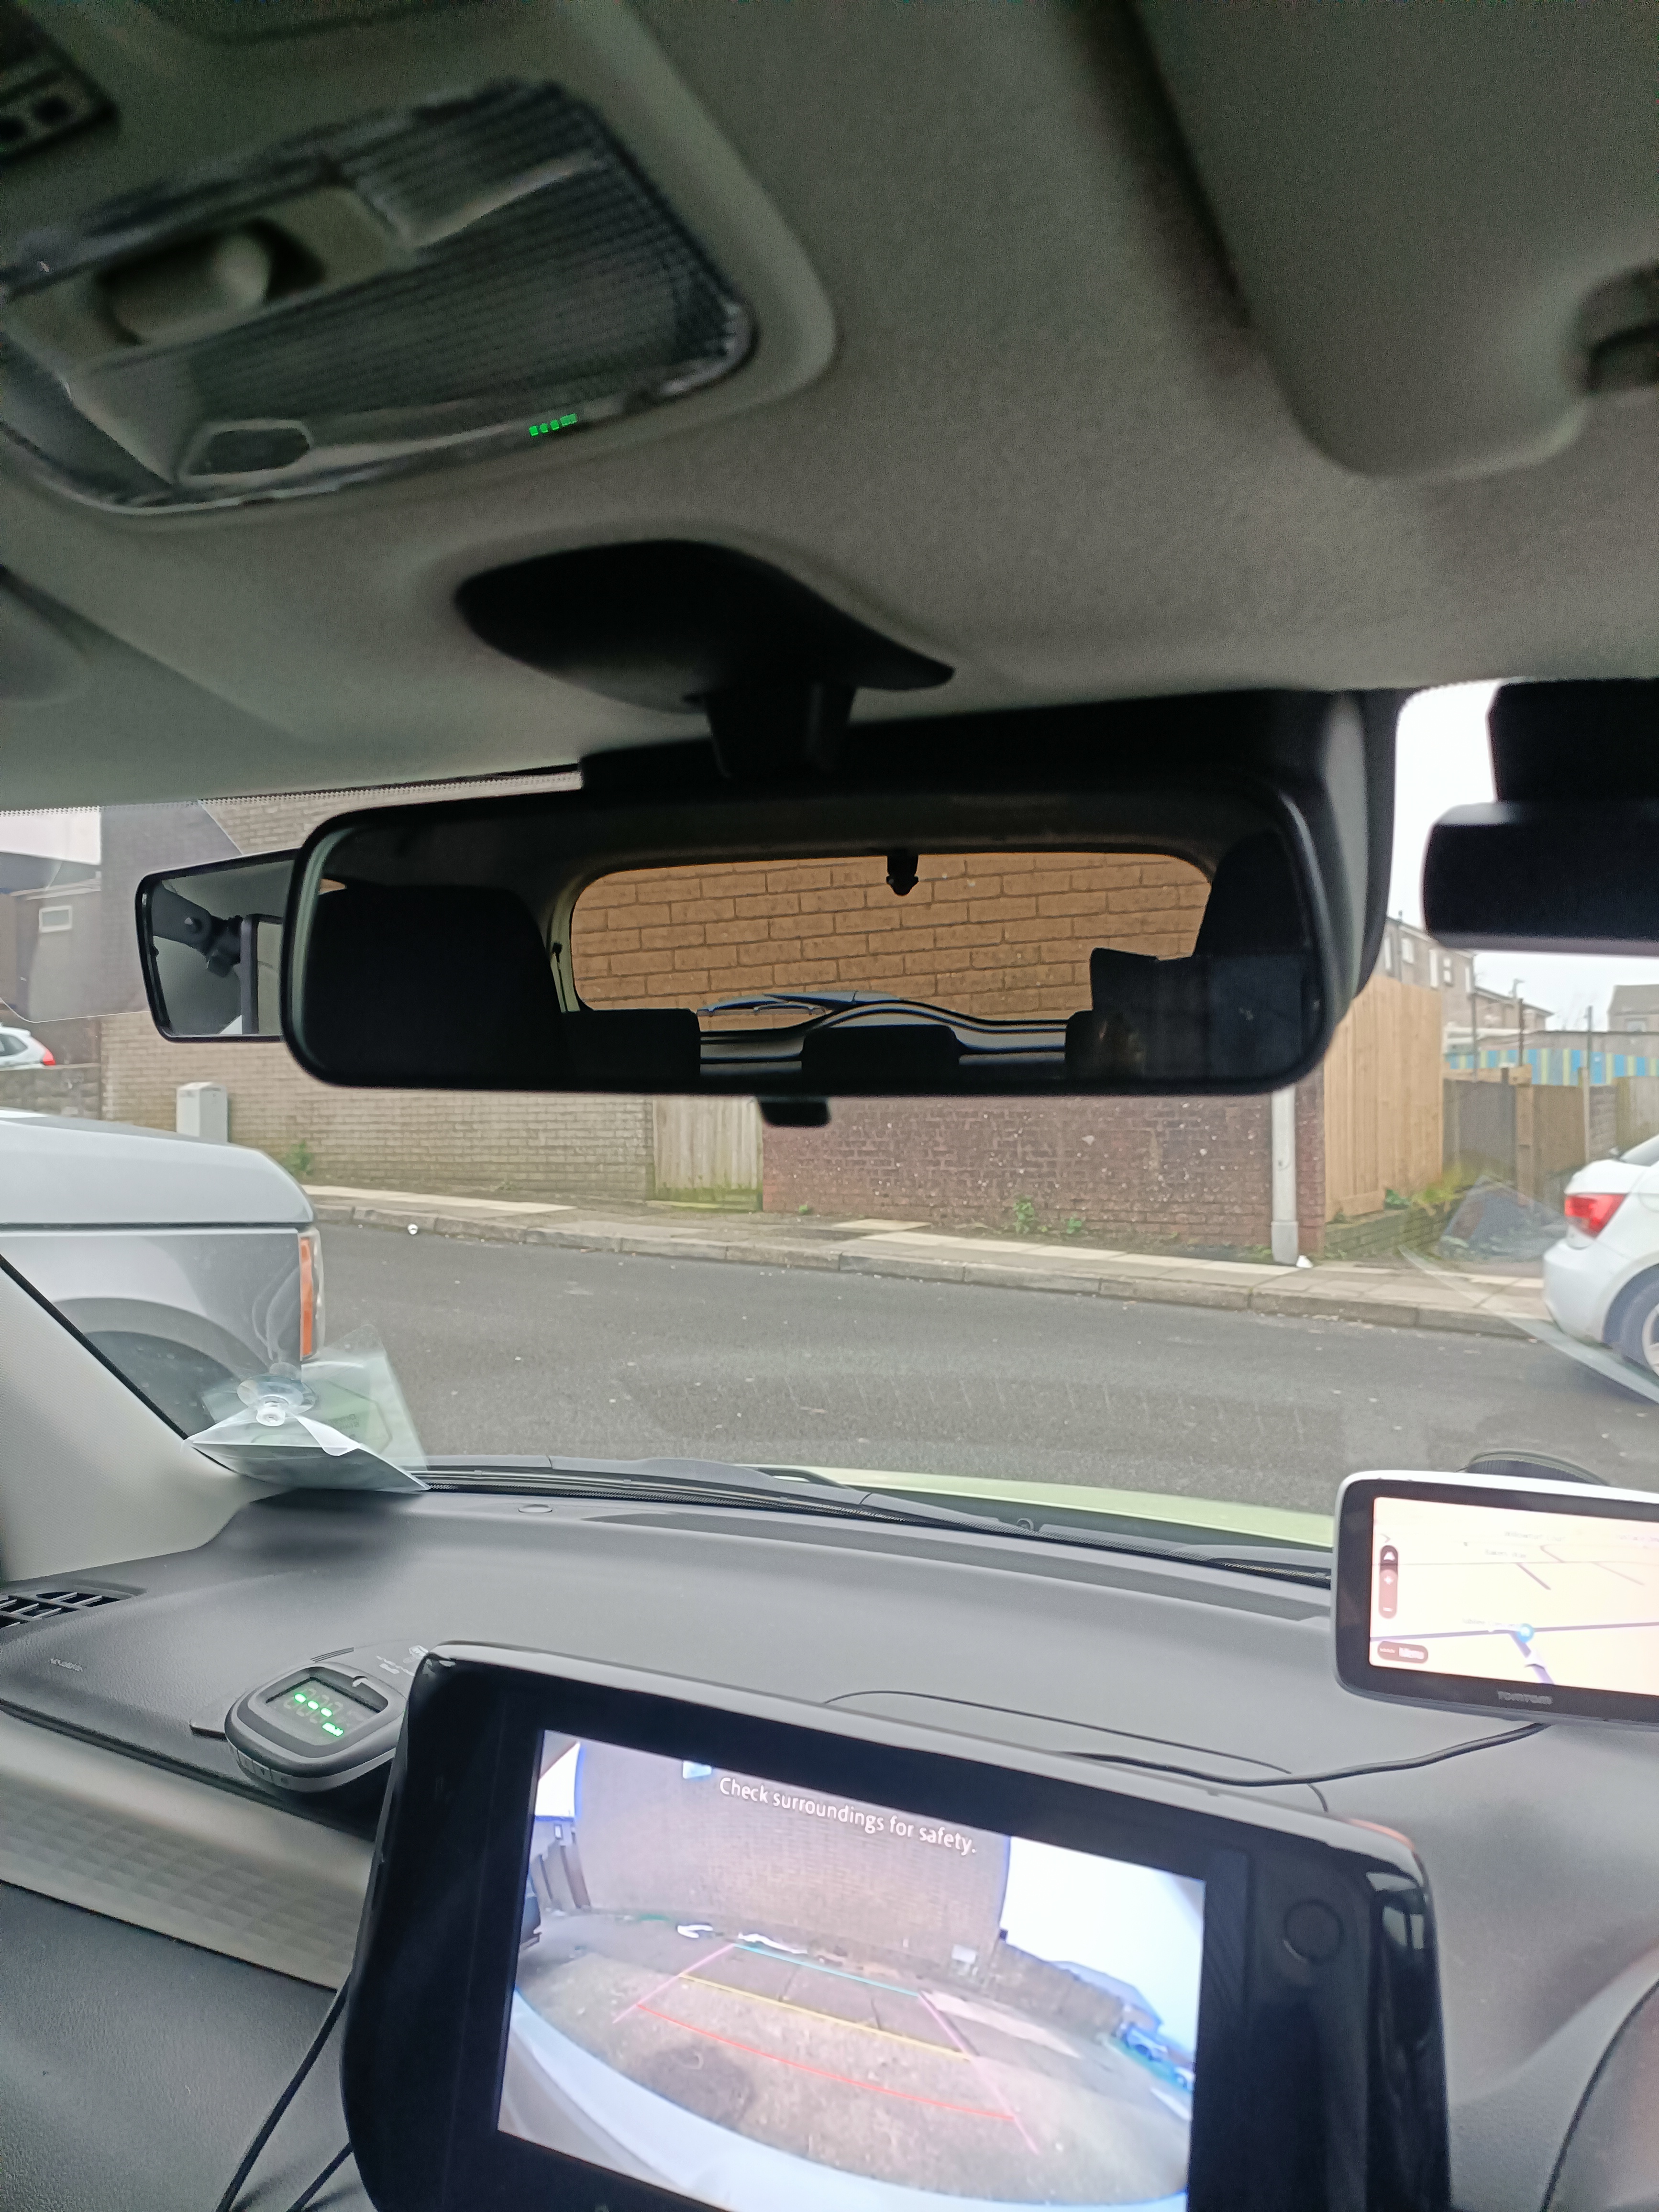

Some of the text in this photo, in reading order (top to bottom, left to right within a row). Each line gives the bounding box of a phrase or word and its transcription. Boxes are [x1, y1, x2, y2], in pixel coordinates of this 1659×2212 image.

[719, 1777, 977, 1856] Check surroundings for safety.
